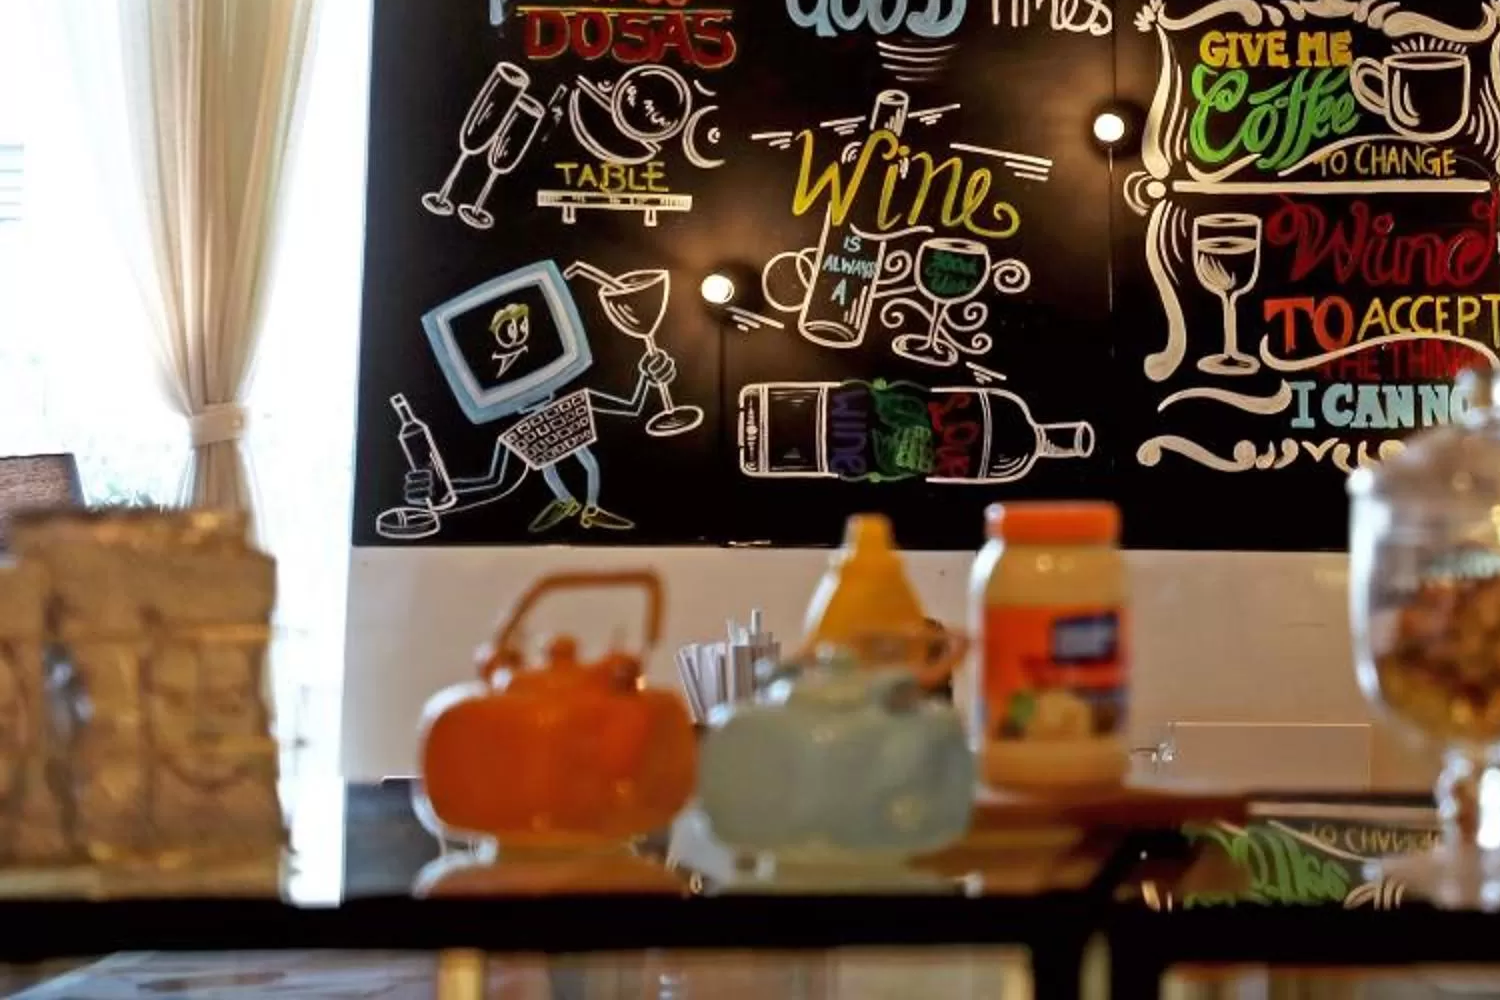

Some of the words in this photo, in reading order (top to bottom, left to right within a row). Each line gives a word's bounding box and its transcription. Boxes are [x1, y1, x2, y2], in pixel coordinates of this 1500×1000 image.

[524, 8, 737, 69] DOSAS
[1199, 29, 1291, 69] GIVE
[1296, 29, 1353, 68] ME
[1189, 63, 1362, 171] Coffee
[554, 161, 670, 193] TABLE
[792, 129, 1021, 239] Wine
[1312, 150, 1348, 177] TO
[1354, 142, 1458, 177] CHANGE
[843, 235, 862, 253] IS
[1263, 294, 1354, 352] TO
[1289, 379, 1317, 428] I
